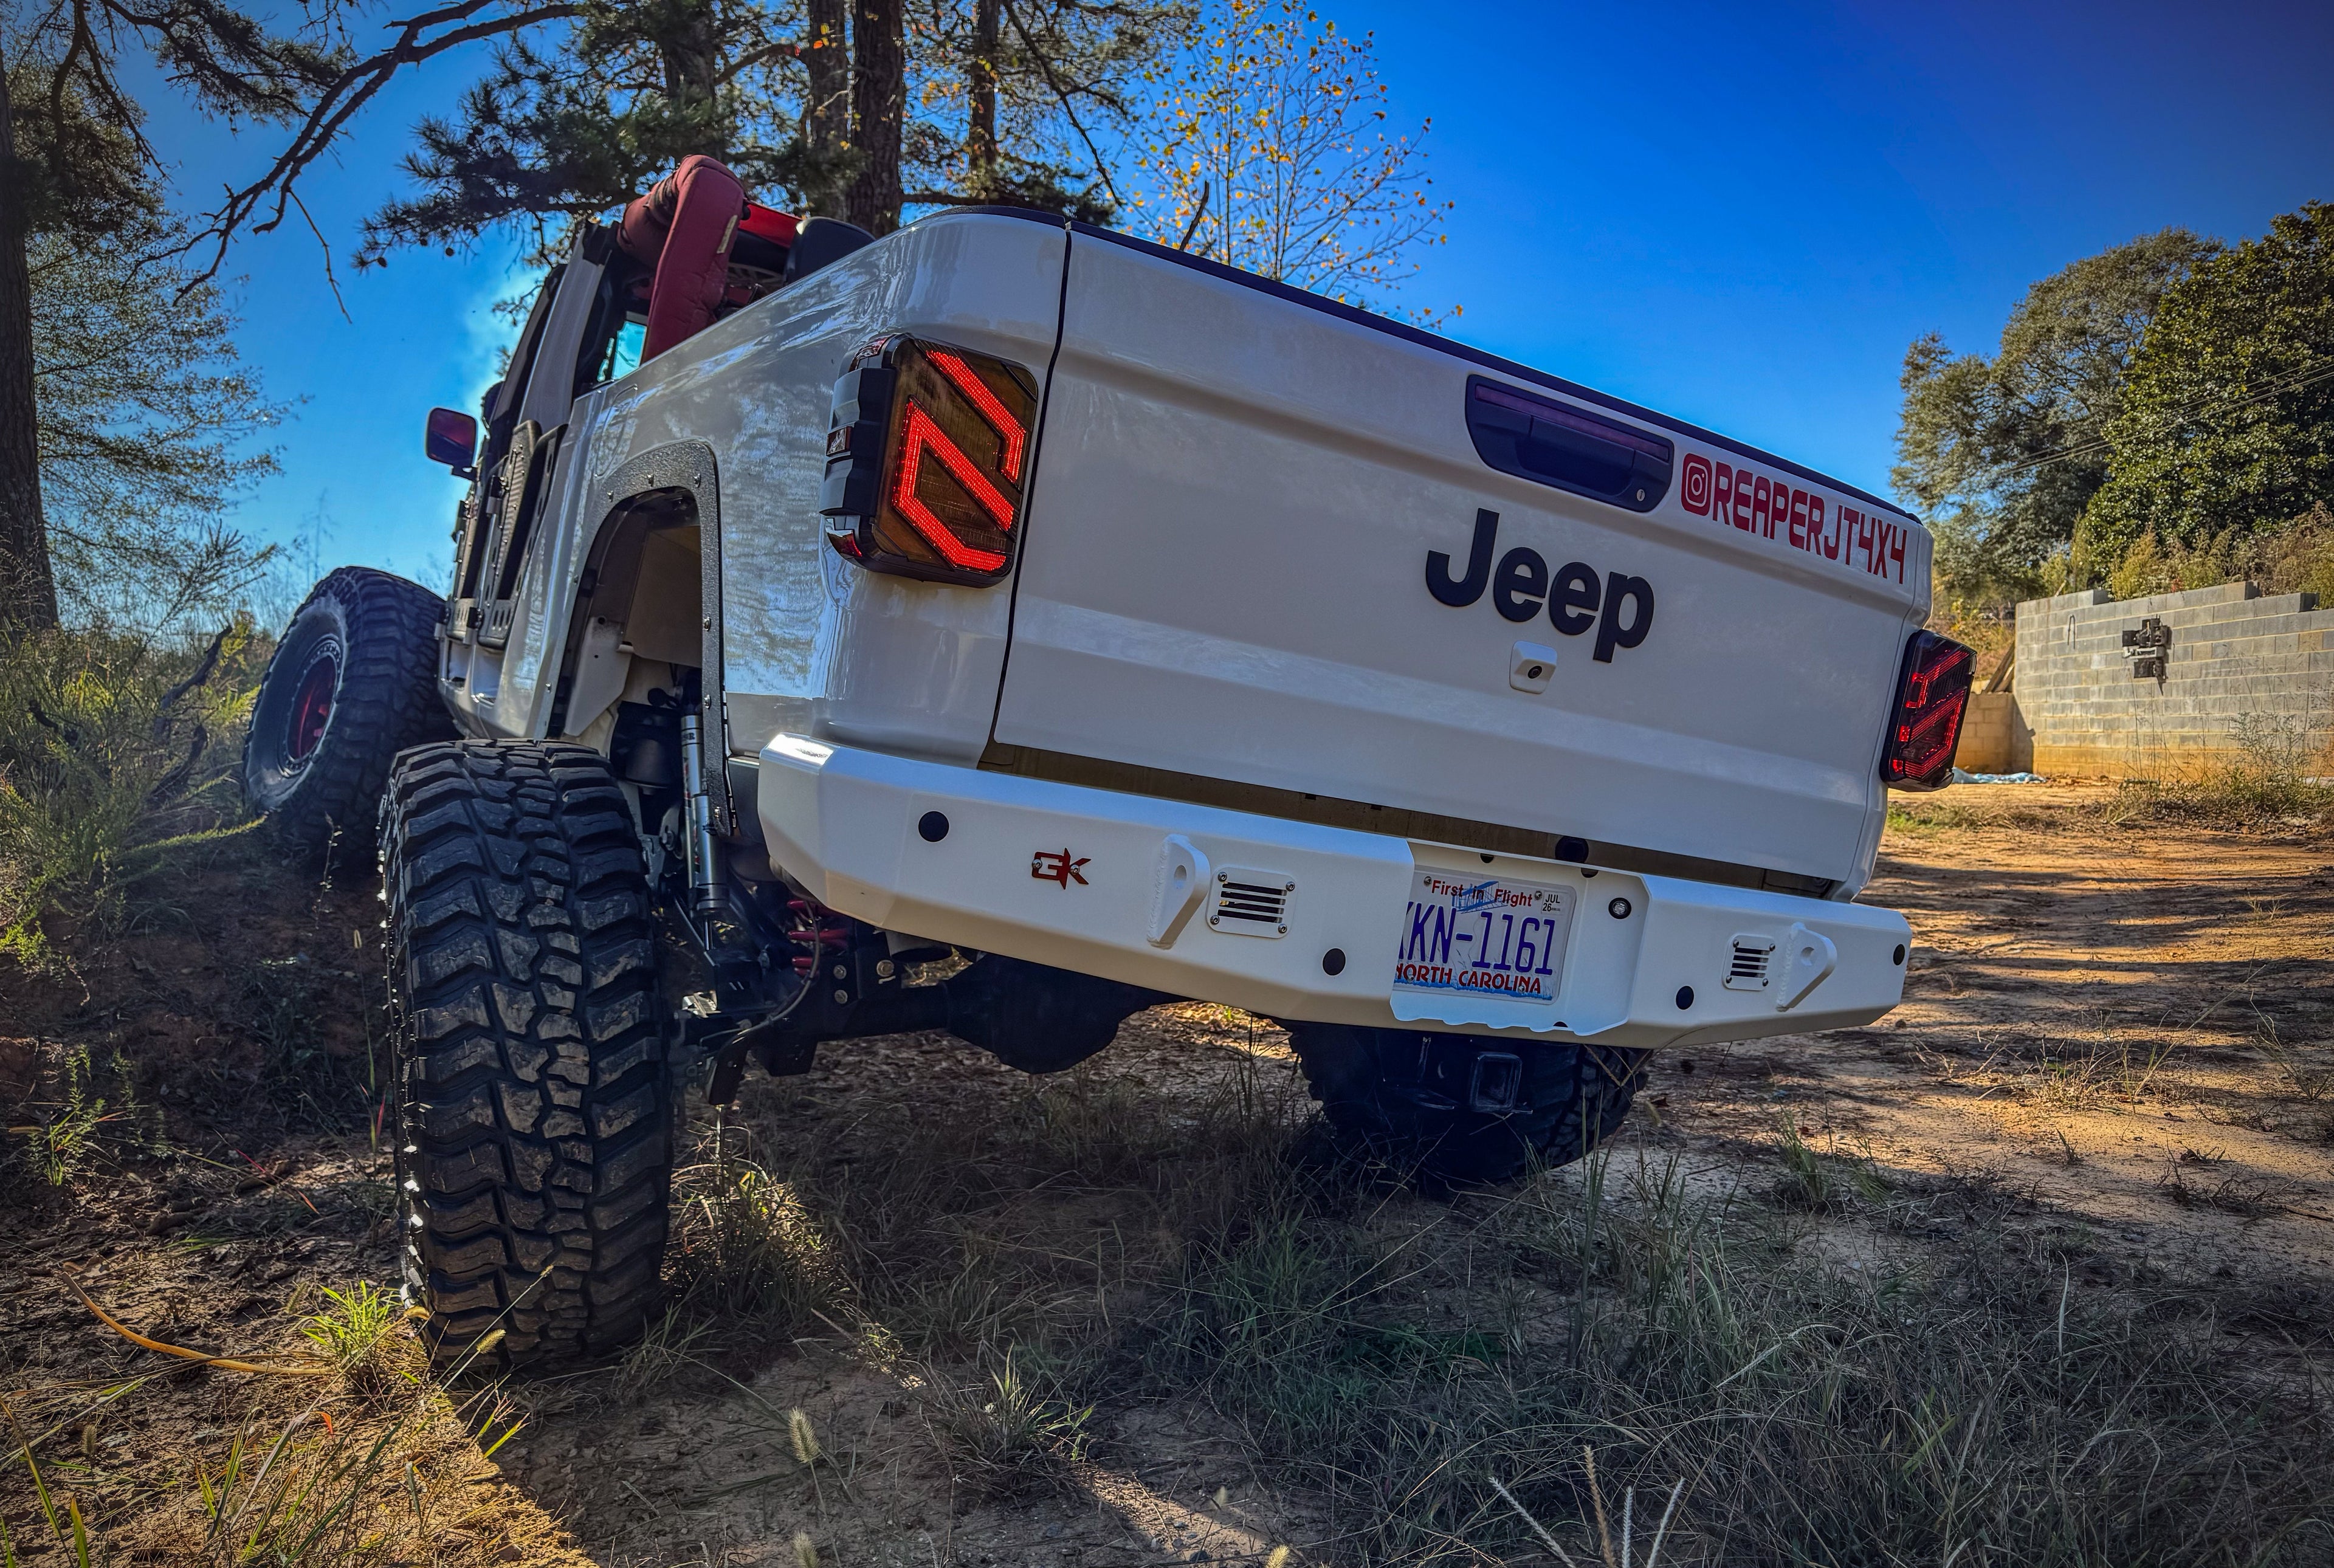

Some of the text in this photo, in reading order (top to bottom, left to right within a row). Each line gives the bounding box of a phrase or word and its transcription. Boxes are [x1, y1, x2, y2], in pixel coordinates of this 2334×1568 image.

[1425, 508, 1654, 663] Jeep
[1431, 880, 1533, 907] First in Flight
[1545, 894, 1560, 904] JUL
[1542, 903, 1552, 912] 26
[1459, 971, 1541, 994] CAROLINA
